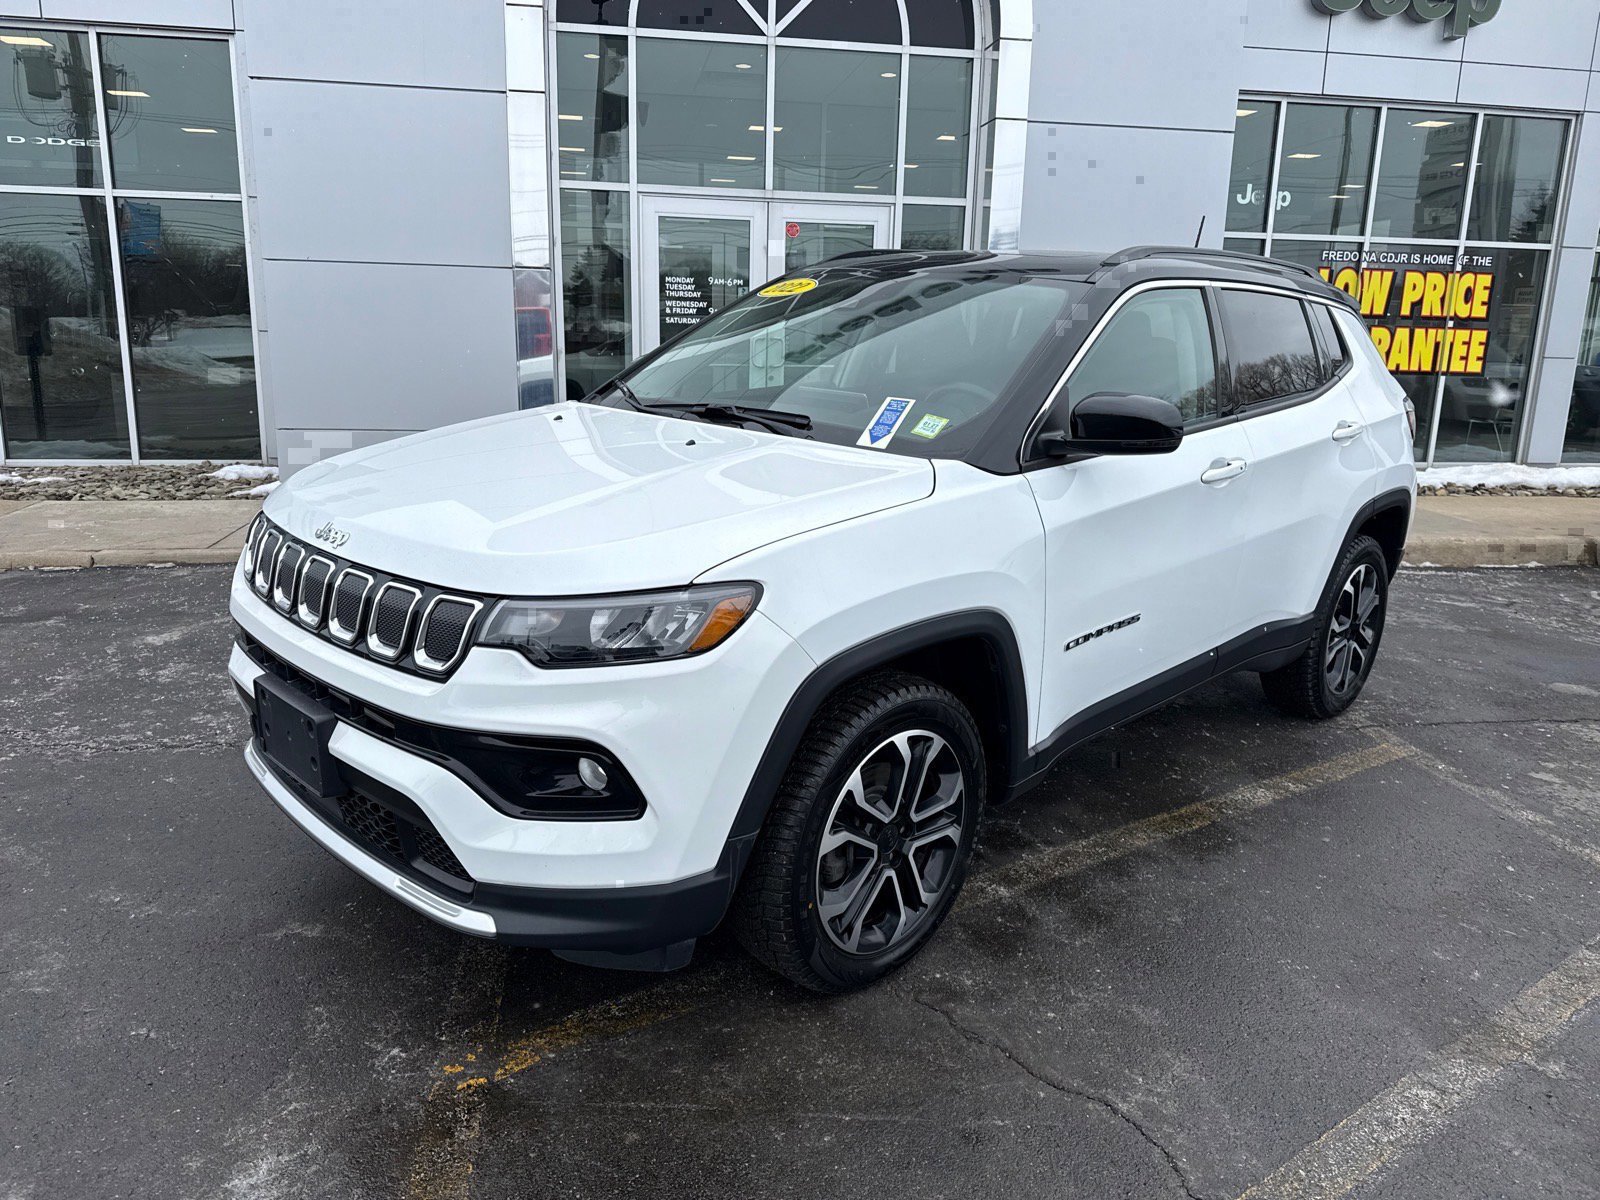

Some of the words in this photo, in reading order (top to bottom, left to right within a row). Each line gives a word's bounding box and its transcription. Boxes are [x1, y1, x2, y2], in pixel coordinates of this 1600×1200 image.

[1379, 252, 1408, 263] CDJR
[1410, 253, 1421, 264] IS
[1423, 254, 1454, 265] HOME
[1472, 256, 1493, 267] THE
[665, 276, 695, 284] MONDAY
[665, 283, 696, 291] TUESDAY
[665, 290, 701, 298] THURSDAY
[1400, 269, 1493, 319] PRICE
[665, 300, 708, 308] WEDNESDAY
[672, 307, 697, 315] FRIDAY
[665, 316, 700, 324] SATURDAY
[315, 521, 350, 549] Jeep
[1064, 613, 1141, 652] COMPASS
